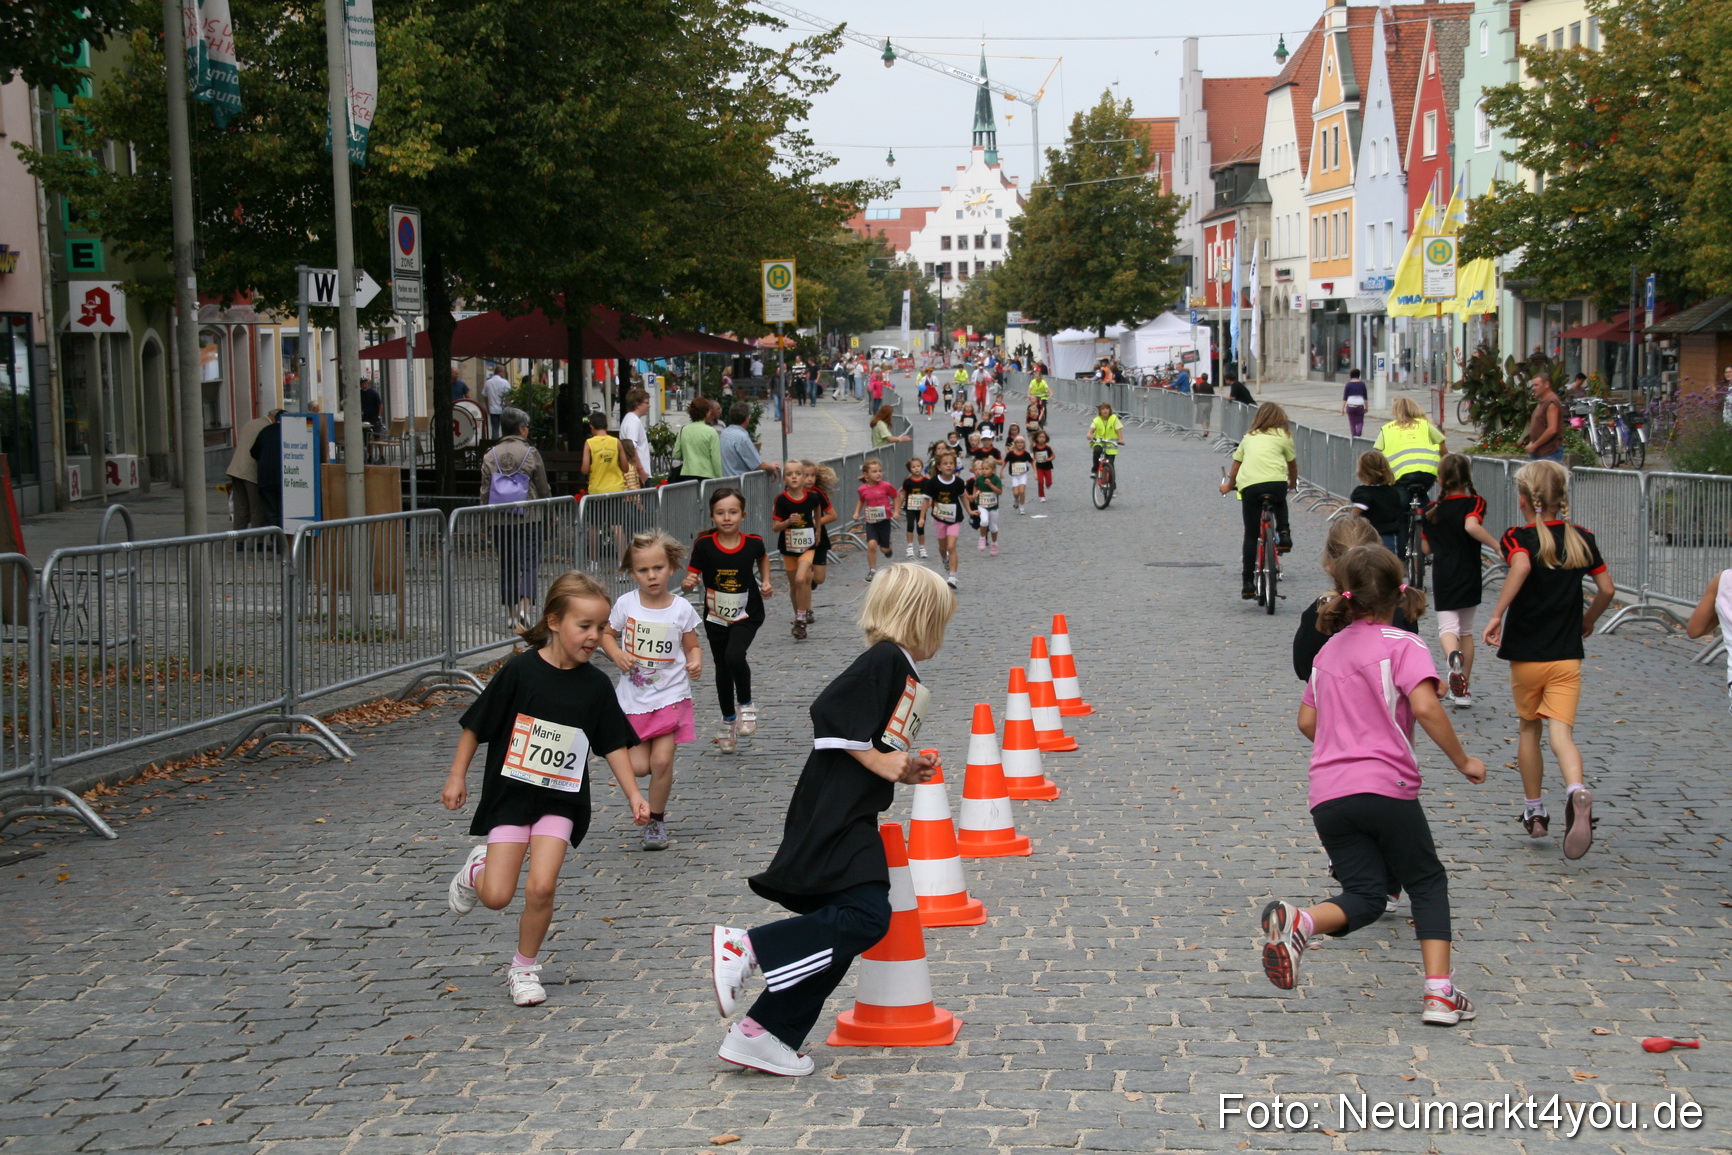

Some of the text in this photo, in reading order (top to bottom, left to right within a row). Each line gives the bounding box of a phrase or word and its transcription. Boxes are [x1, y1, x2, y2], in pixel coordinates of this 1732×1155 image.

[953, 69, 974, 80] POTAIN
[401, 258, 414, 268] ZONE
[314, 272, 336, 302] W
[300, 442, 308, 450] Land
[284, 465, 299, 475] Zukunft
[290, 478, 308, 489] Familien.
[718, 606, 743, 618] 7227
[637, 624, 650, 634] Eva
[637, 638, 673, 653] 7159
[532, 724, 562, 742] Marie
[529, 744, 577, 770] 7092
